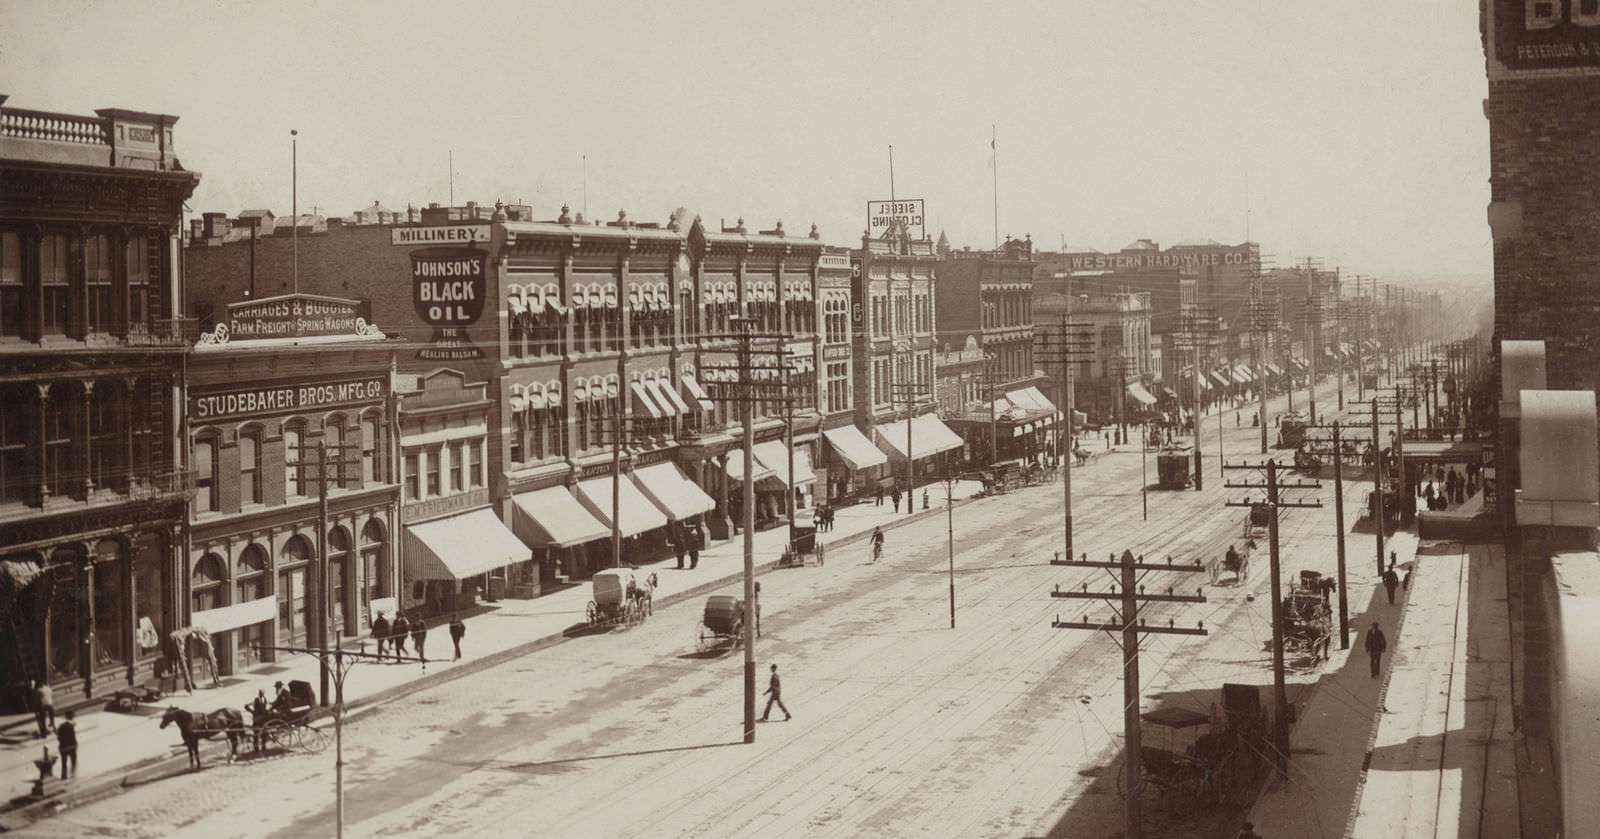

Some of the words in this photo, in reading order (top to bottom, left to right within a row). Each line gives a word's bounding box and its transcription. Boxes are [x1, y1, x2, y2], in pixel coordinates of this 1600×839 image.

[414, 259, 481, 277] JOHNSON'S
[1071, 255, 1142, 269] WESTERN
[1146, 253, 1218, 267] HARDWARE
[420, 280, 475, 302] BLACK
[292, 299, 303, 316] &
[428, 305, 470, 321] OIL
[231, 319, 257, 336] FARM
[255, 318, 291, 335] FREIGHT
[296, 317, 325, 332] SPRING
[323, 316, 355, 331] WAGONS
[443, 328, 457, 337] THE
[197, 388, 294, 417] STUDEBAKER
